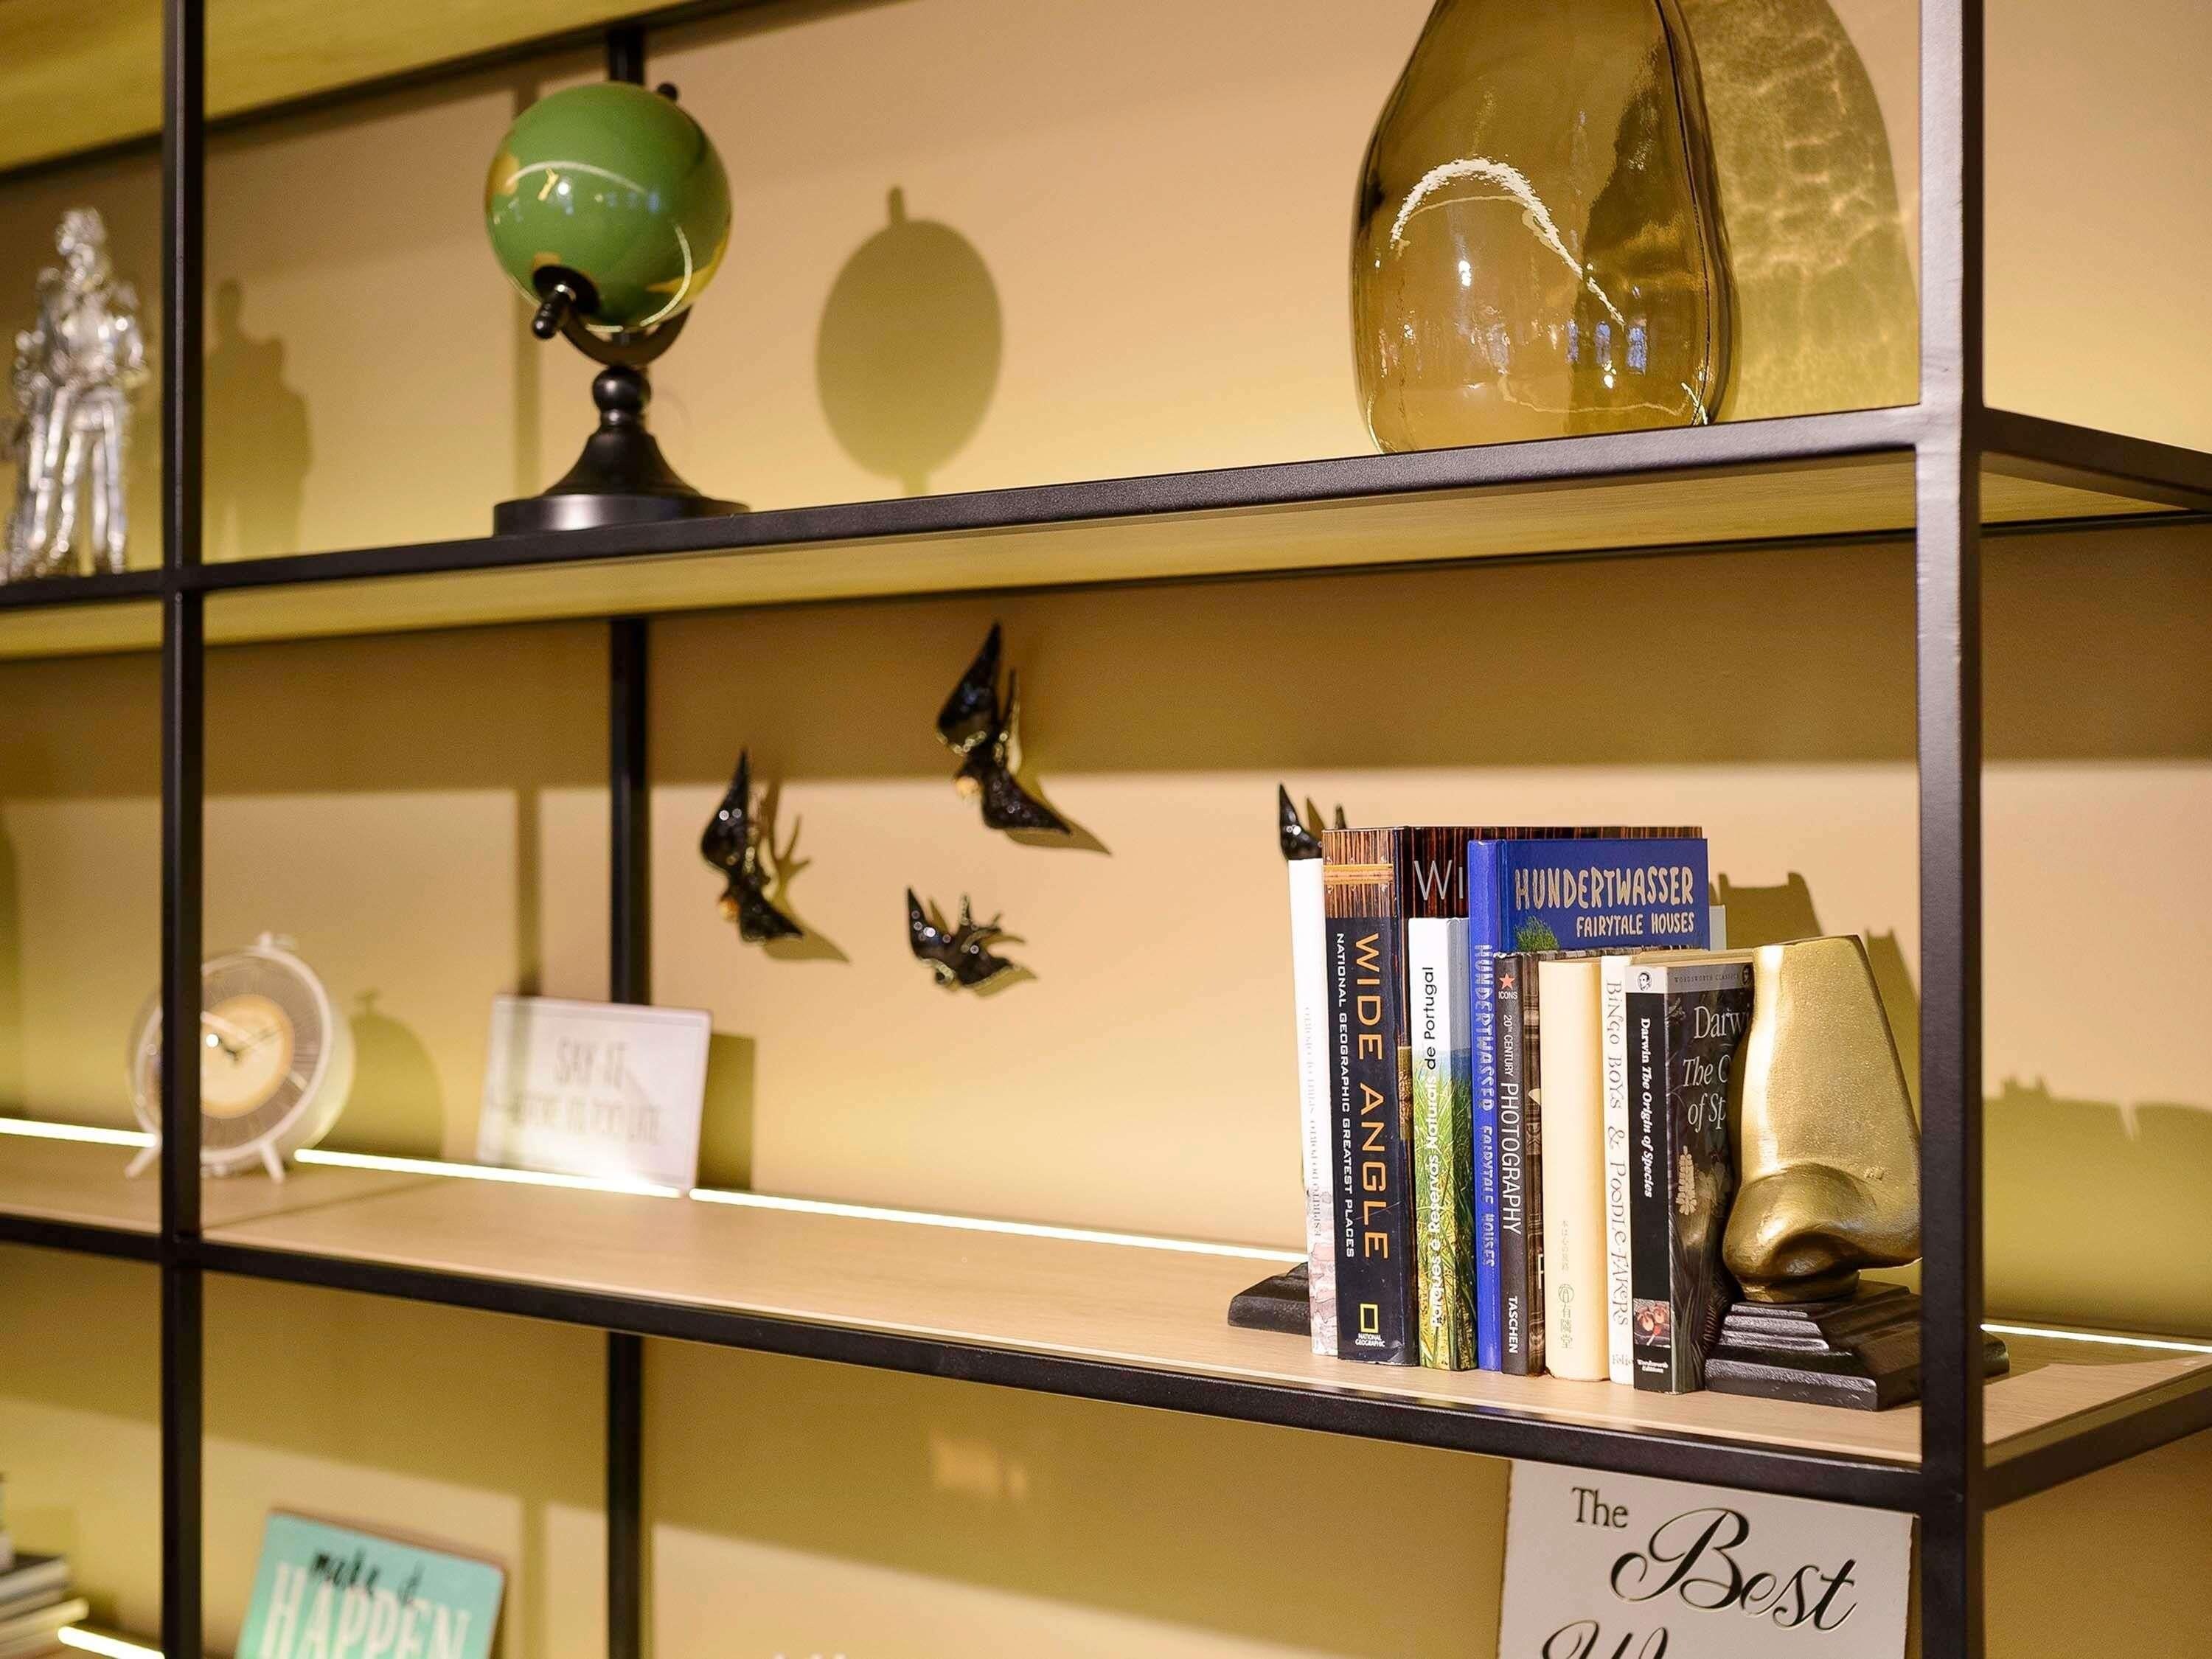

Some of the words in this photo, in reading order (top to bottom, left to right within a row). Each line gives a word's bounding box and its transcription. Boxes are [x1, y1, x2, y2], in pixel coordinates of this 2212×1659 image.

[1414, 860, 1464, 901] WI
[1514, 866, 1694, 911] HUNDERTWASSER
[1576, 914, 1644, 938] FAIRYTALE
[1652, 912, 1695, 934] HOUSES
[1336, 933, 1348, 1007] NATIONAL
[1355, 933, 1382, 1060] WIDE
[1422, 967, 1437, 1039] Portugal
[1498, 991, 1518, 1000] ICONS
[1339, 1012, 1350, 1112] GEOGRAPHIC
[1423, 1046, 1436, 1070] de
[1504, 1034, 1514, 1077] CENTURY
[1641, 1018, 1651, 1063] Darwin
[1608, 1057, 1624, 1109] BOYS
[1641, 1066, 1652, 1090] The
[1683, 1055, 1714, 1087] The
[1425, 1075, 1439, 1149] Naturais
[1641, 1091, 1652, 1133] Origin
[1688, 1093, 1708, 1133] of
[1342, 1118, 1353, 1194] GREATEST
[1500, 1082, 1522, 1235] PHOTOGRAPHY
[1608, 1126, 1625, 1150] &
[1641, 1135, 1654, 1152] of
[1360, 1082, 1388, 1259] ANGLE
[1427, 1154, 1441, 1233] Reservas
[1642, 1150, 1654, 1198] Species
[1345, 1199, 1355, 1258] PLACES
[1508, 1295, 1519, 1354] TASCHEN
[1571, 1486, 1629, 1528] The
[1610, 1507, 1858, 1632] Best
